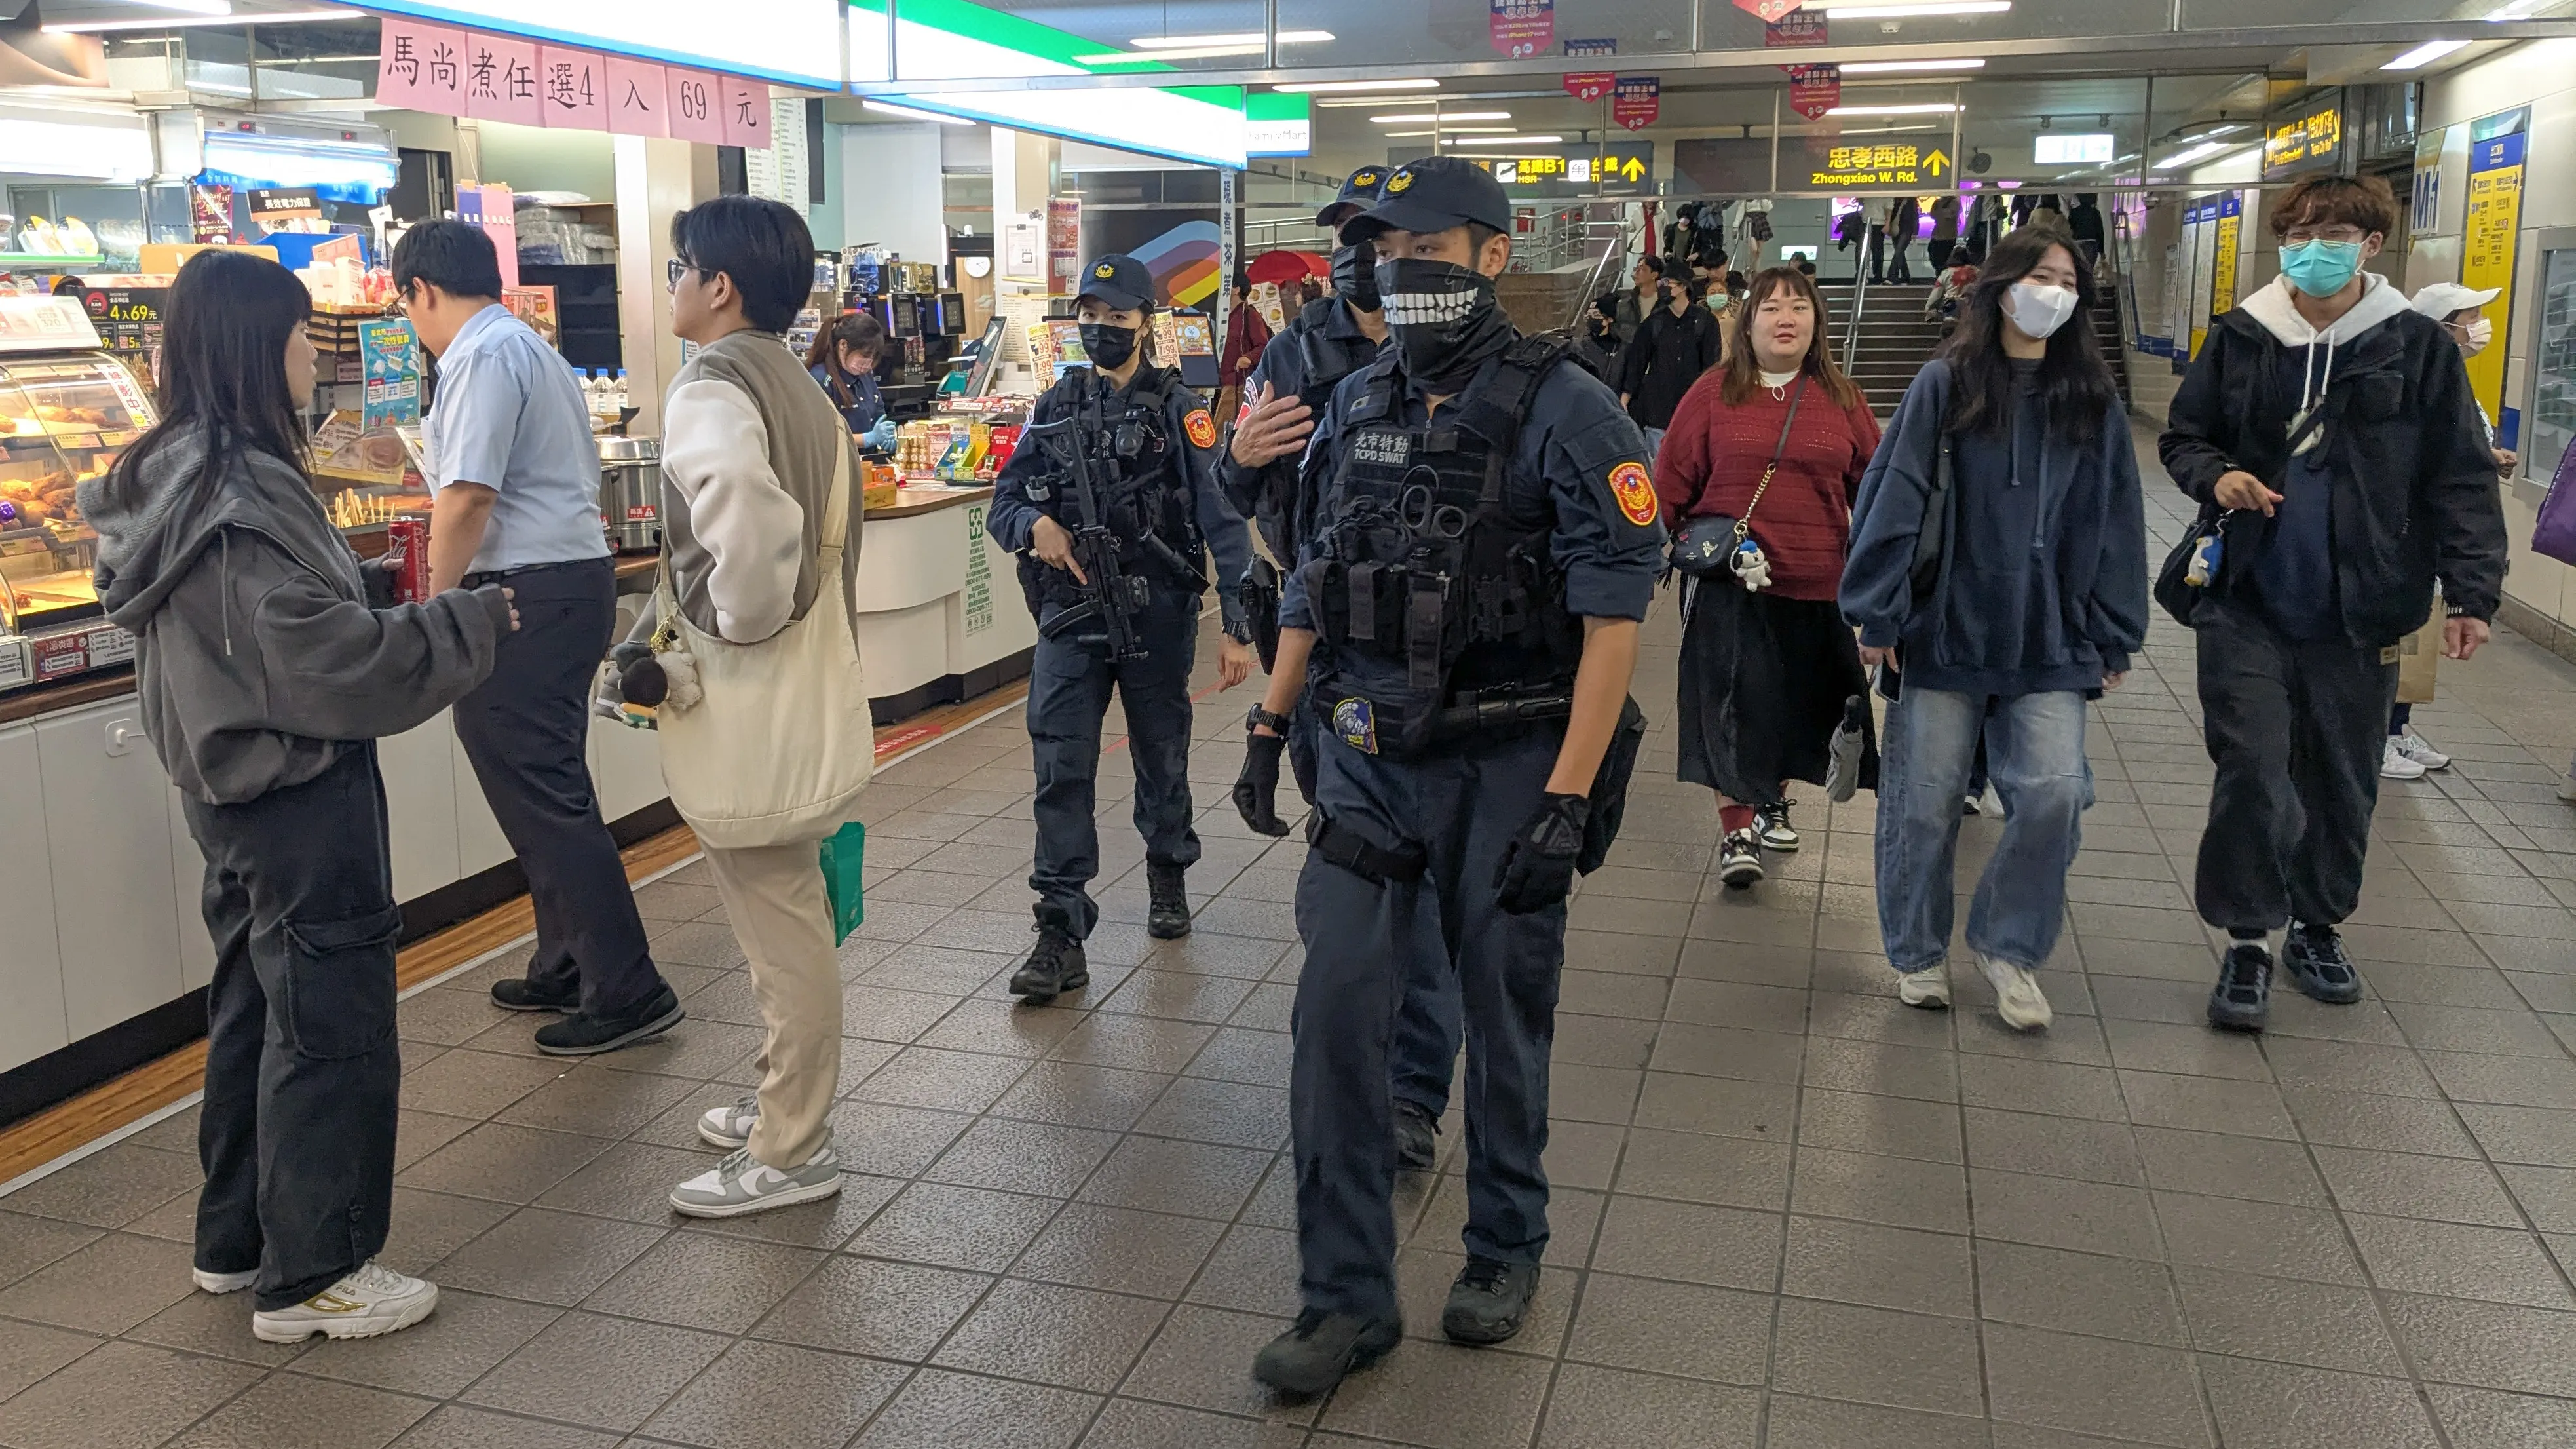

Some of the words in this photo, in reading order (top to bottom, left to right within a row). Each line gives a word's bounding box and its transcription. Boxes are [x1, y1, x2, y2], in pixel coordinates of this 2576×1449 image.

[1248, 130, 1306, 142] FamilyMart
[1828, 145, 1918, 168] 忠孝西路
[1811, 172, 1876, 185] Zhongxiao
[1878, 172, 1894, 183] W.
[1897, 171, 1918, 182] Rd.
[2412, 170, 2440, 230] M1
[109, 305, 157, 320] 4入69元
[1354, 448, 1377, 461] TCPD
[1378, 451, 1407, 464] SWAT
[335, 1284, 356, 1296] FILA
